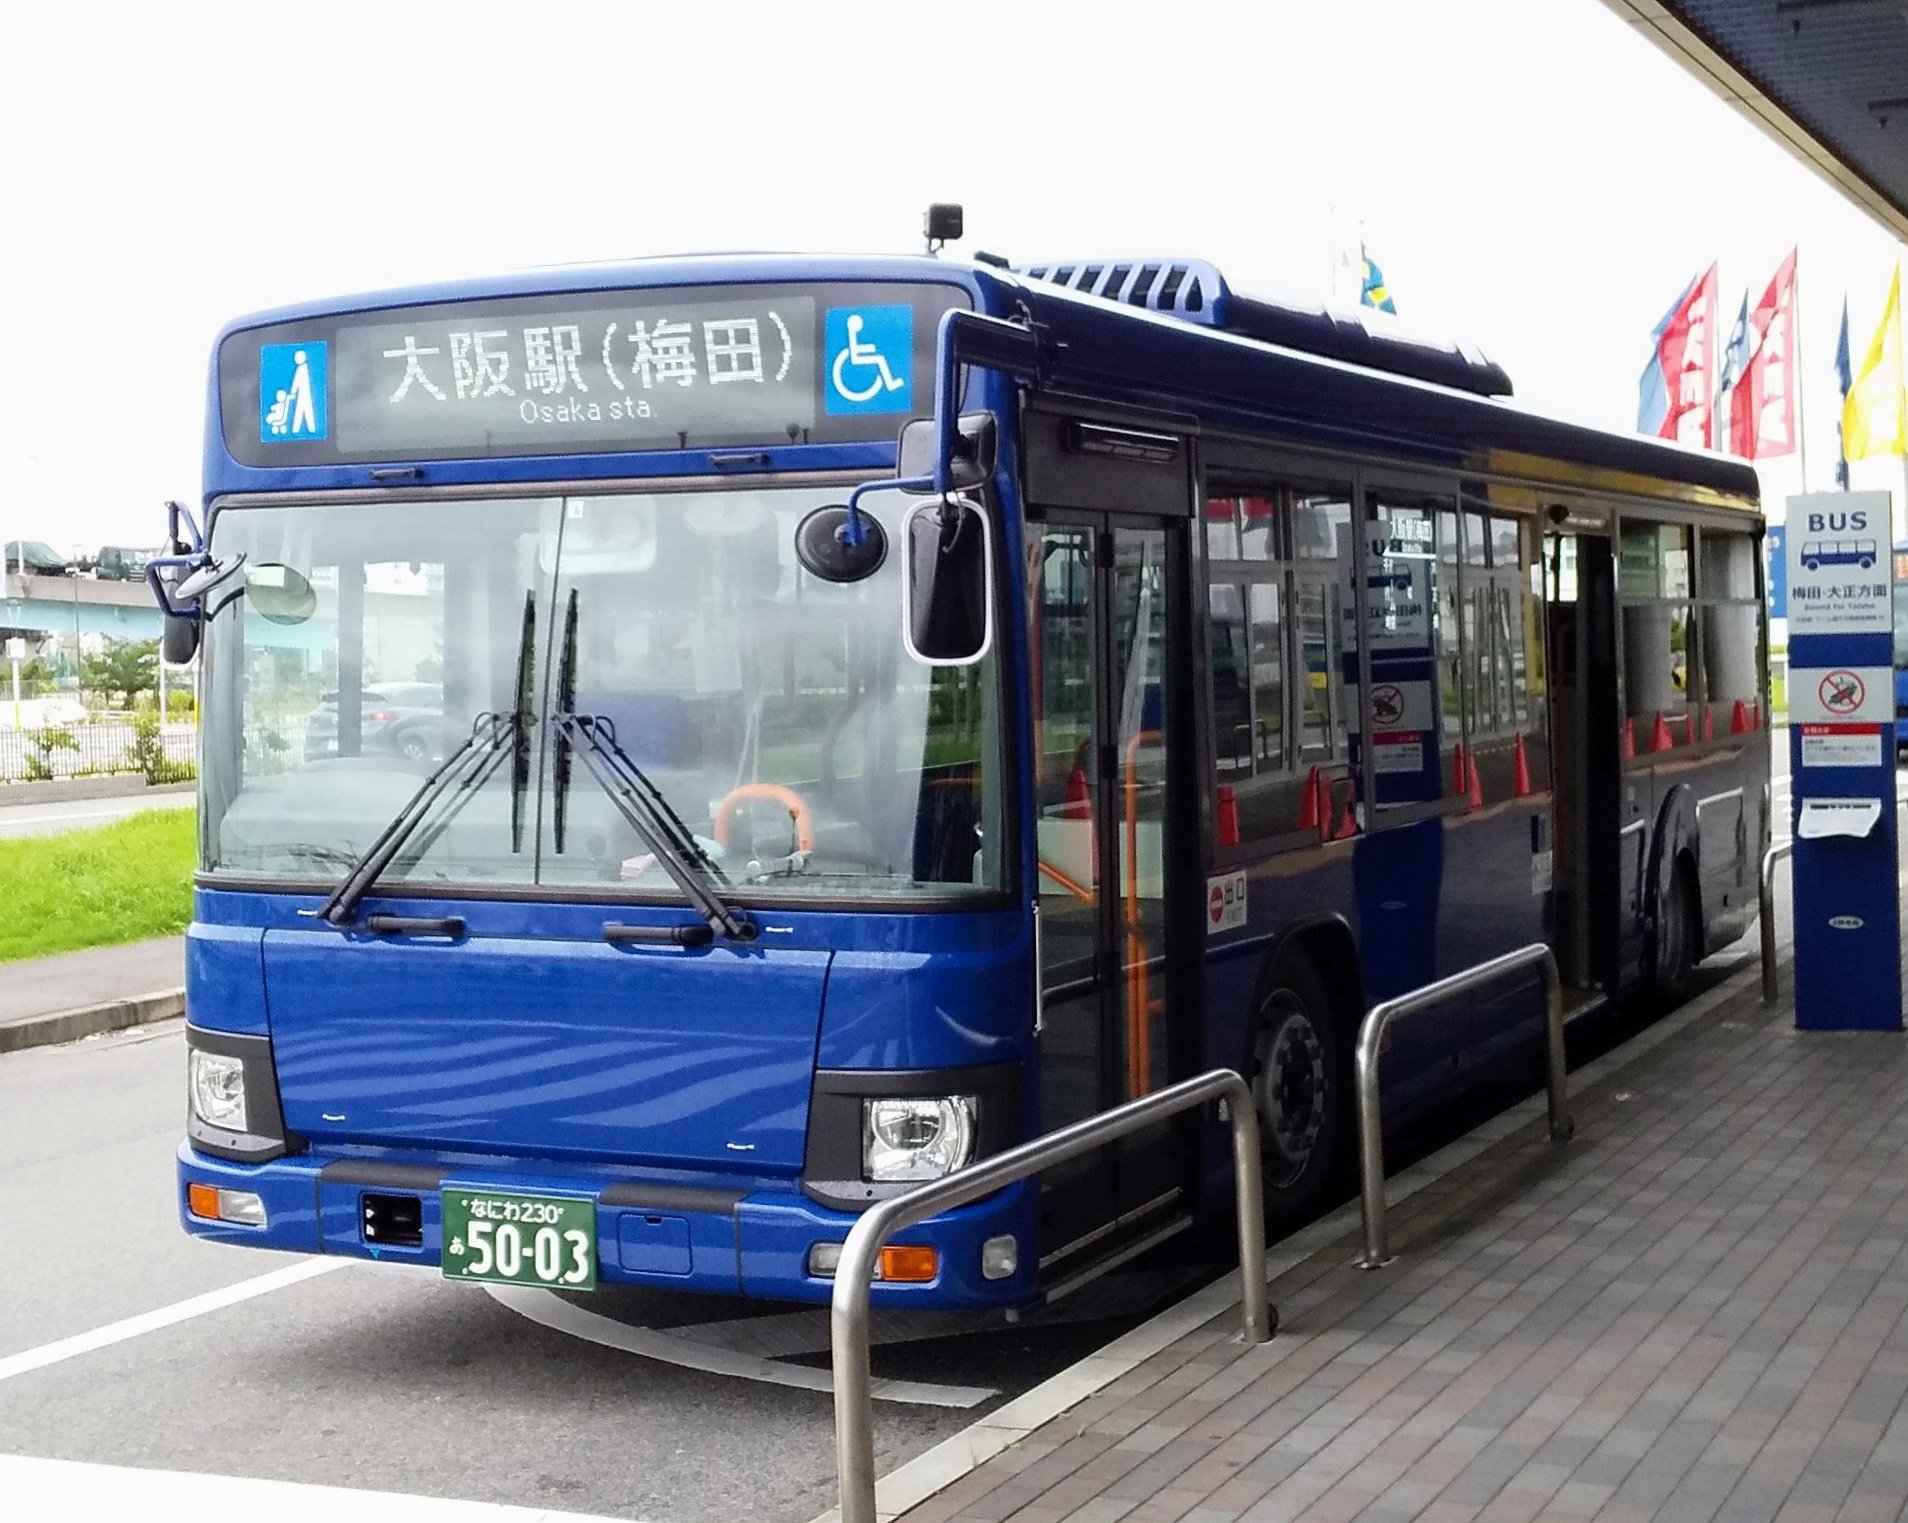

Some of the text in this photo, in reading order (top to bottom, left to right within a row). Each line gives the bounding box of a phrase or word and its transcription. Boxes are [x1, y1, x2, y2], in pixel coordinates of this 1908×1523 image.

[383, 311, 792, 402] 大阪駅(梅田)
[520, 398, 600, 423] Osaka
[1808, 511, 1868, 532] BUS
[449, 1236, 465, 1256] あ
[468, 1220, 589, 1283] 50-03
